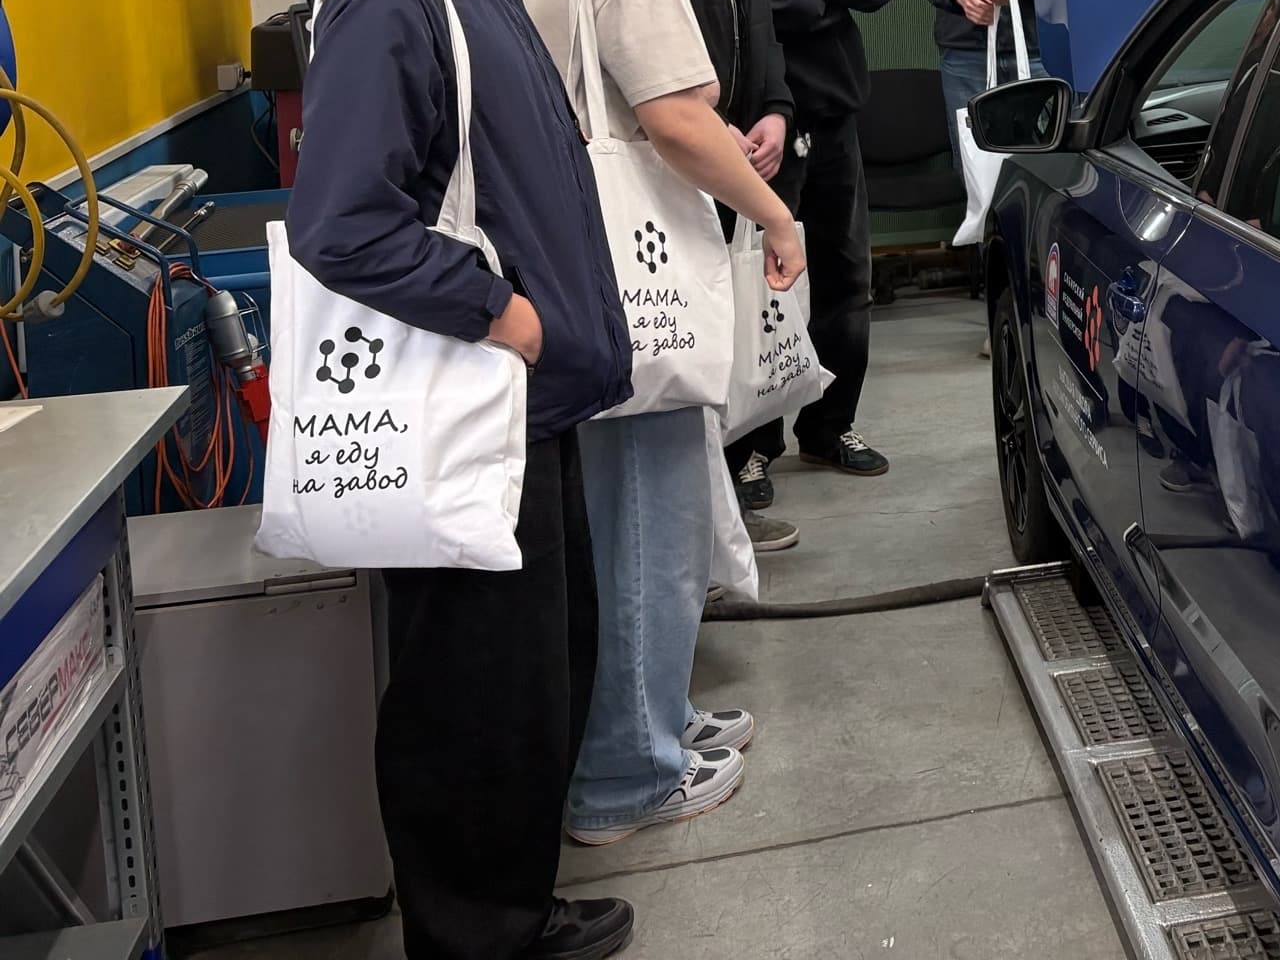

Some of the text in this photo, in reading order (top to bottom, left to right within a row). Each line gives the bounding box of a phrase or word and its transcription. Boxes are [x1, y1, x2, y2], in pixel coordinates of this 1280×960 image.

[621, 288, 688, 308] МАМА,
[633, 311, 677, 333] я еду
[632, 332, 695, 357] а завод
[779, 352, 801, 371] еду
[293, 409, 409, 438] МАМА,
[305, 441, 380, 470] я еду
[292, 466, 408, 499] на завод
